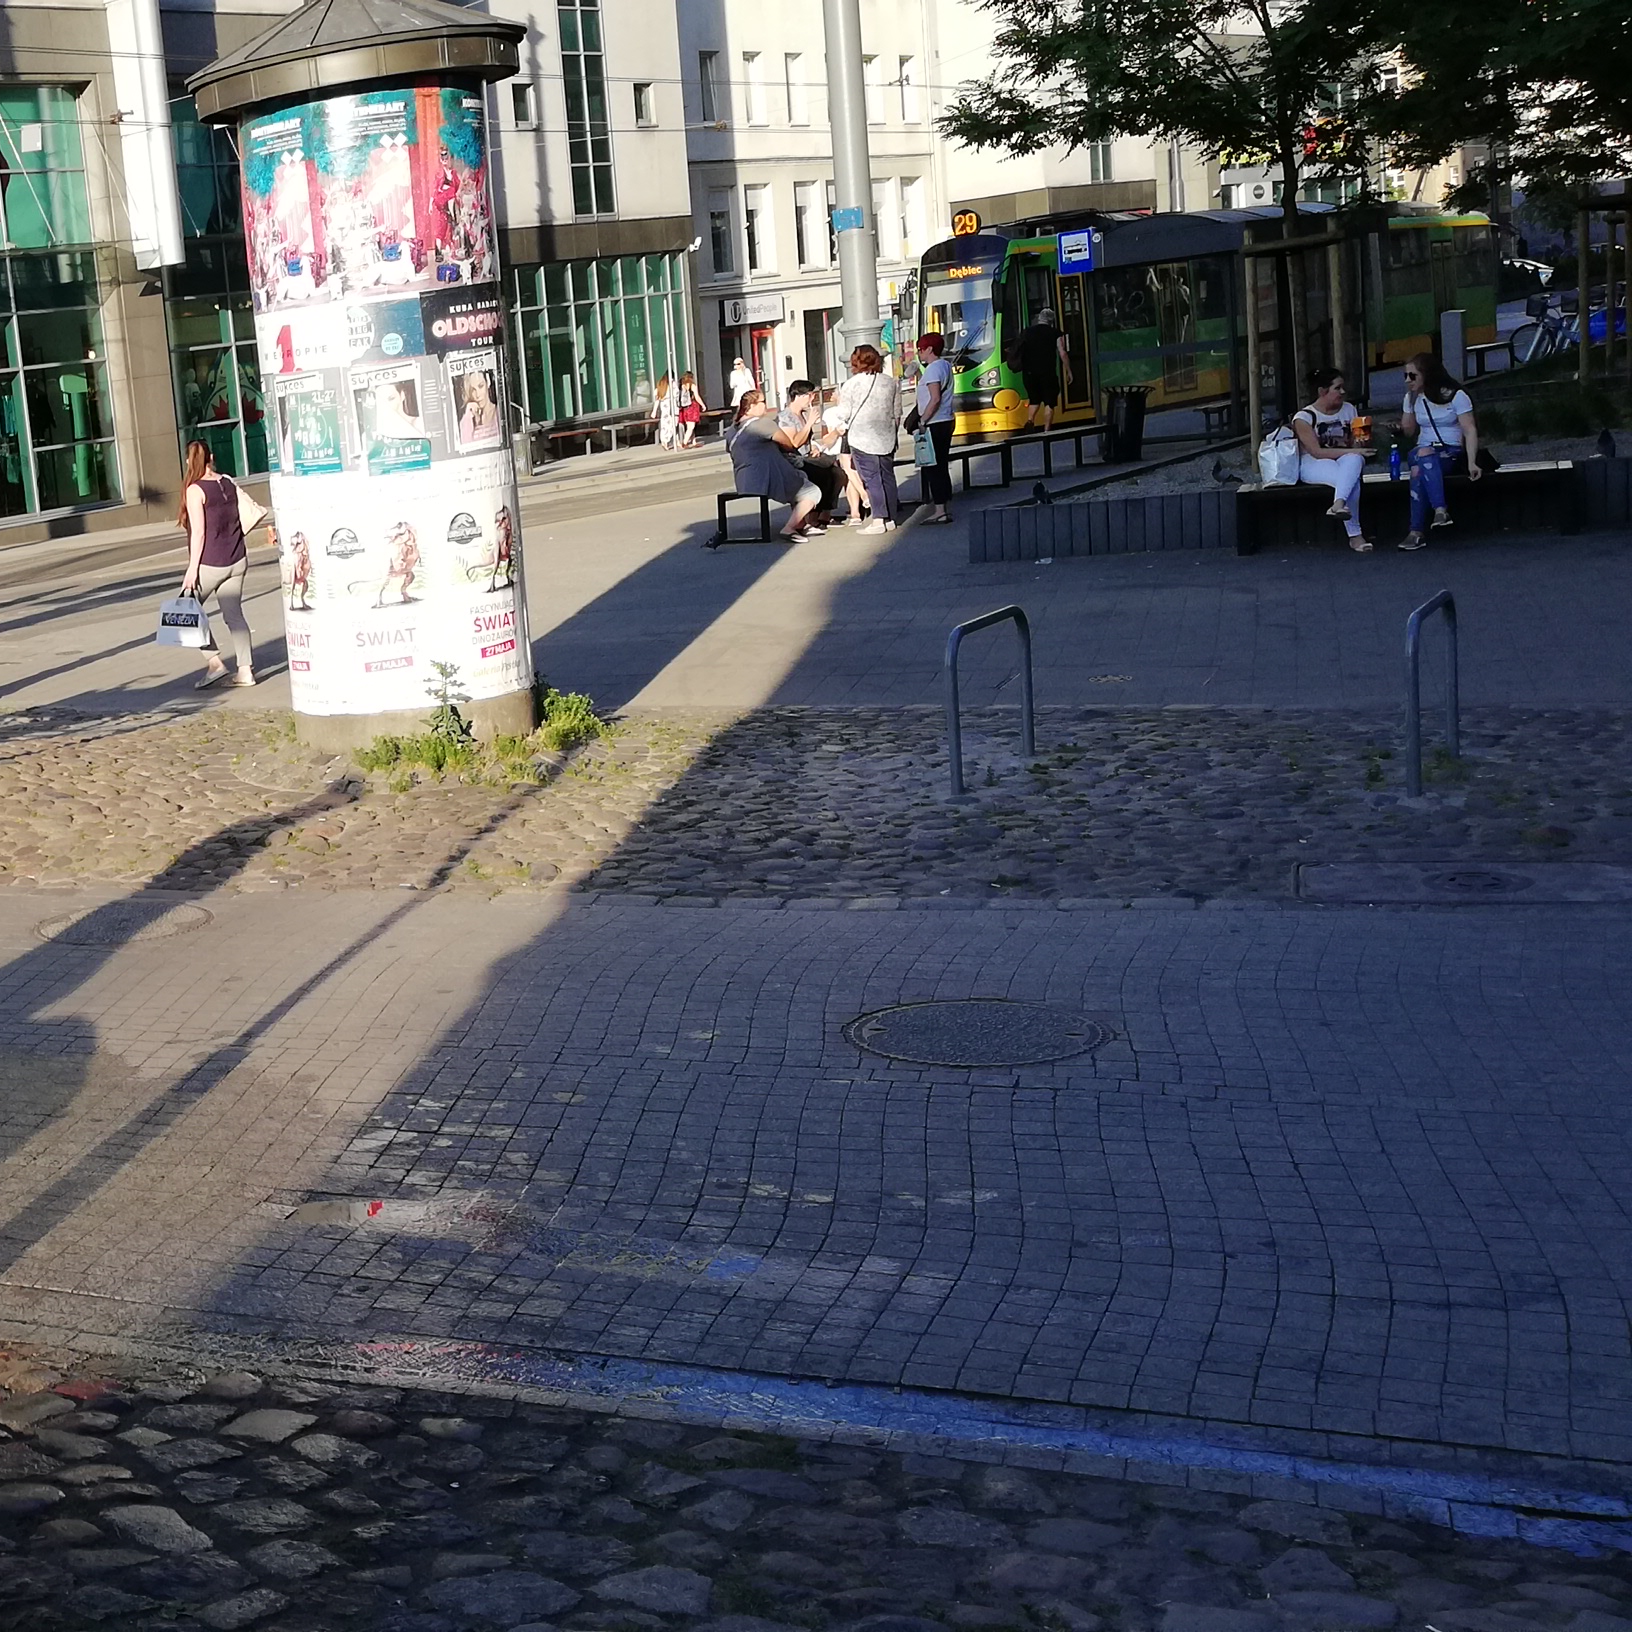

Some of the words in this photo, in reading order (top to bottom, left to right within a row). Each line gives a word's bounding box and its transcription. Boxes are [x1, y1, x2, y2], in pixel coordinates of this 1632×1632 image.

[954, 213, 977, 236] 29
[949, 266, 982, 278] Dębiec
[449, 303, 473, 314] KUBA
[431, 311, 502, 338] OLDSCHO
[470, 335, 494, 347] TOUR
[951, 364, 966, 374] 17
[469, 599, 515, 615] FASCYNUJĄC
[473, 609, 516, 633] ŚWIAT
[355, 627, 417, 647] ŚWIAT
[471, 626, 517, 645] DINOZAURÓ
